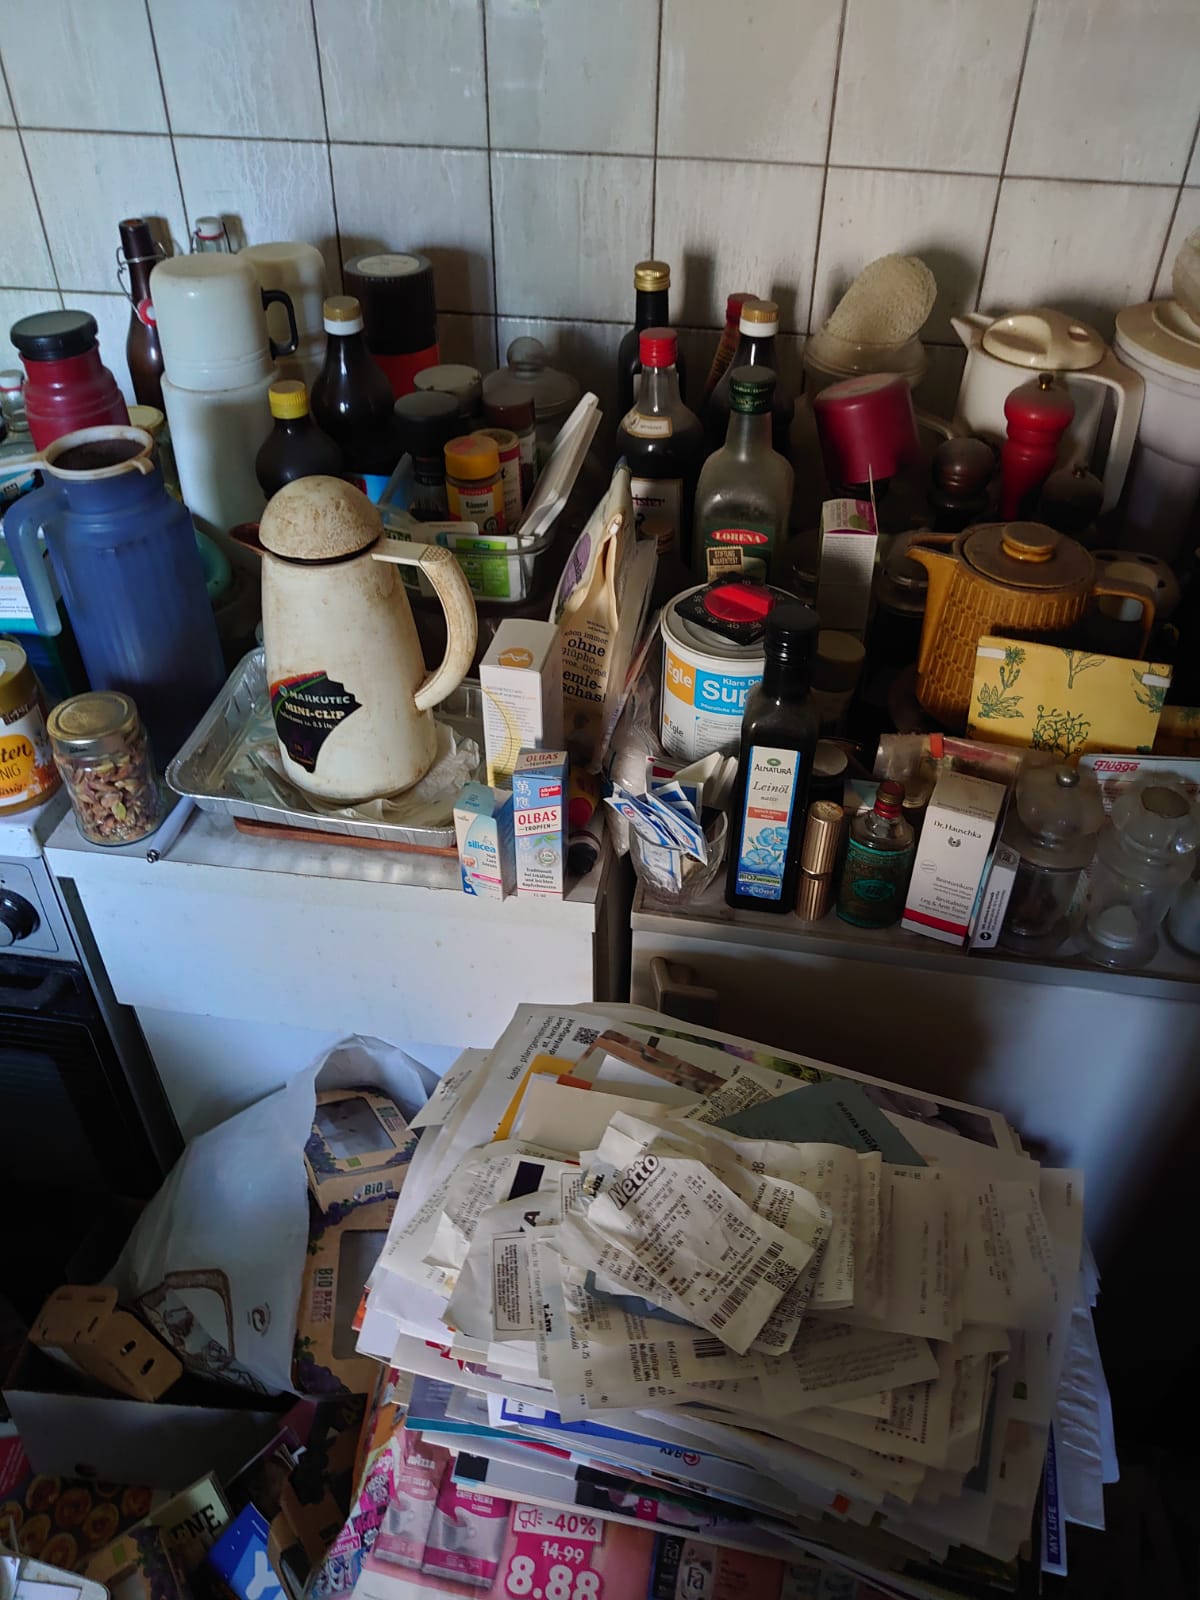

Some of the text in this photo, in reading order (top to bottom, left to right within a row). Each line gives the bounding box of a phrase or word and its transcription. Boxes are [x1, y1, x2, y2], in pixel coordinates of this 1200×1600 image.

[714, 531, 763, 544] LORENA
[713, 549, 737, 558] STIFTUNG
[567, 637, 606, 657] ohne
[666, 659, 693, 688] Egle
[722, 677, 746, 687] Klare
[289, 690, 351, 705] MARKUTEC
[284, 701, 346, 720] MINI-CLIP
[668, 720, 685, 738] Egle
[525, 752, 558, 763] OLBAS
[1093, 760, 1141, 773] Flügge
[752, 781, 790, 794] Leinöl
[518, 810, 557, 826] OLBAS
[525, 824, 551, 832] TROPFEN
[467, 840, 496, 854] silicea
[364, 1181, 383, 1196] BiO
[608, 1153, 660, 1211] Netto
[317, 1267, 334, 1288] BiO
[547, 1512, 597, 1537] -40%
[1047, 1504, 1060, 1531] LIFE
[542, 1541, 586, 1564] 14.99
[1048, 1532, 1060, 1556] MY
[507, 1555, 602, 1600] 8.88
